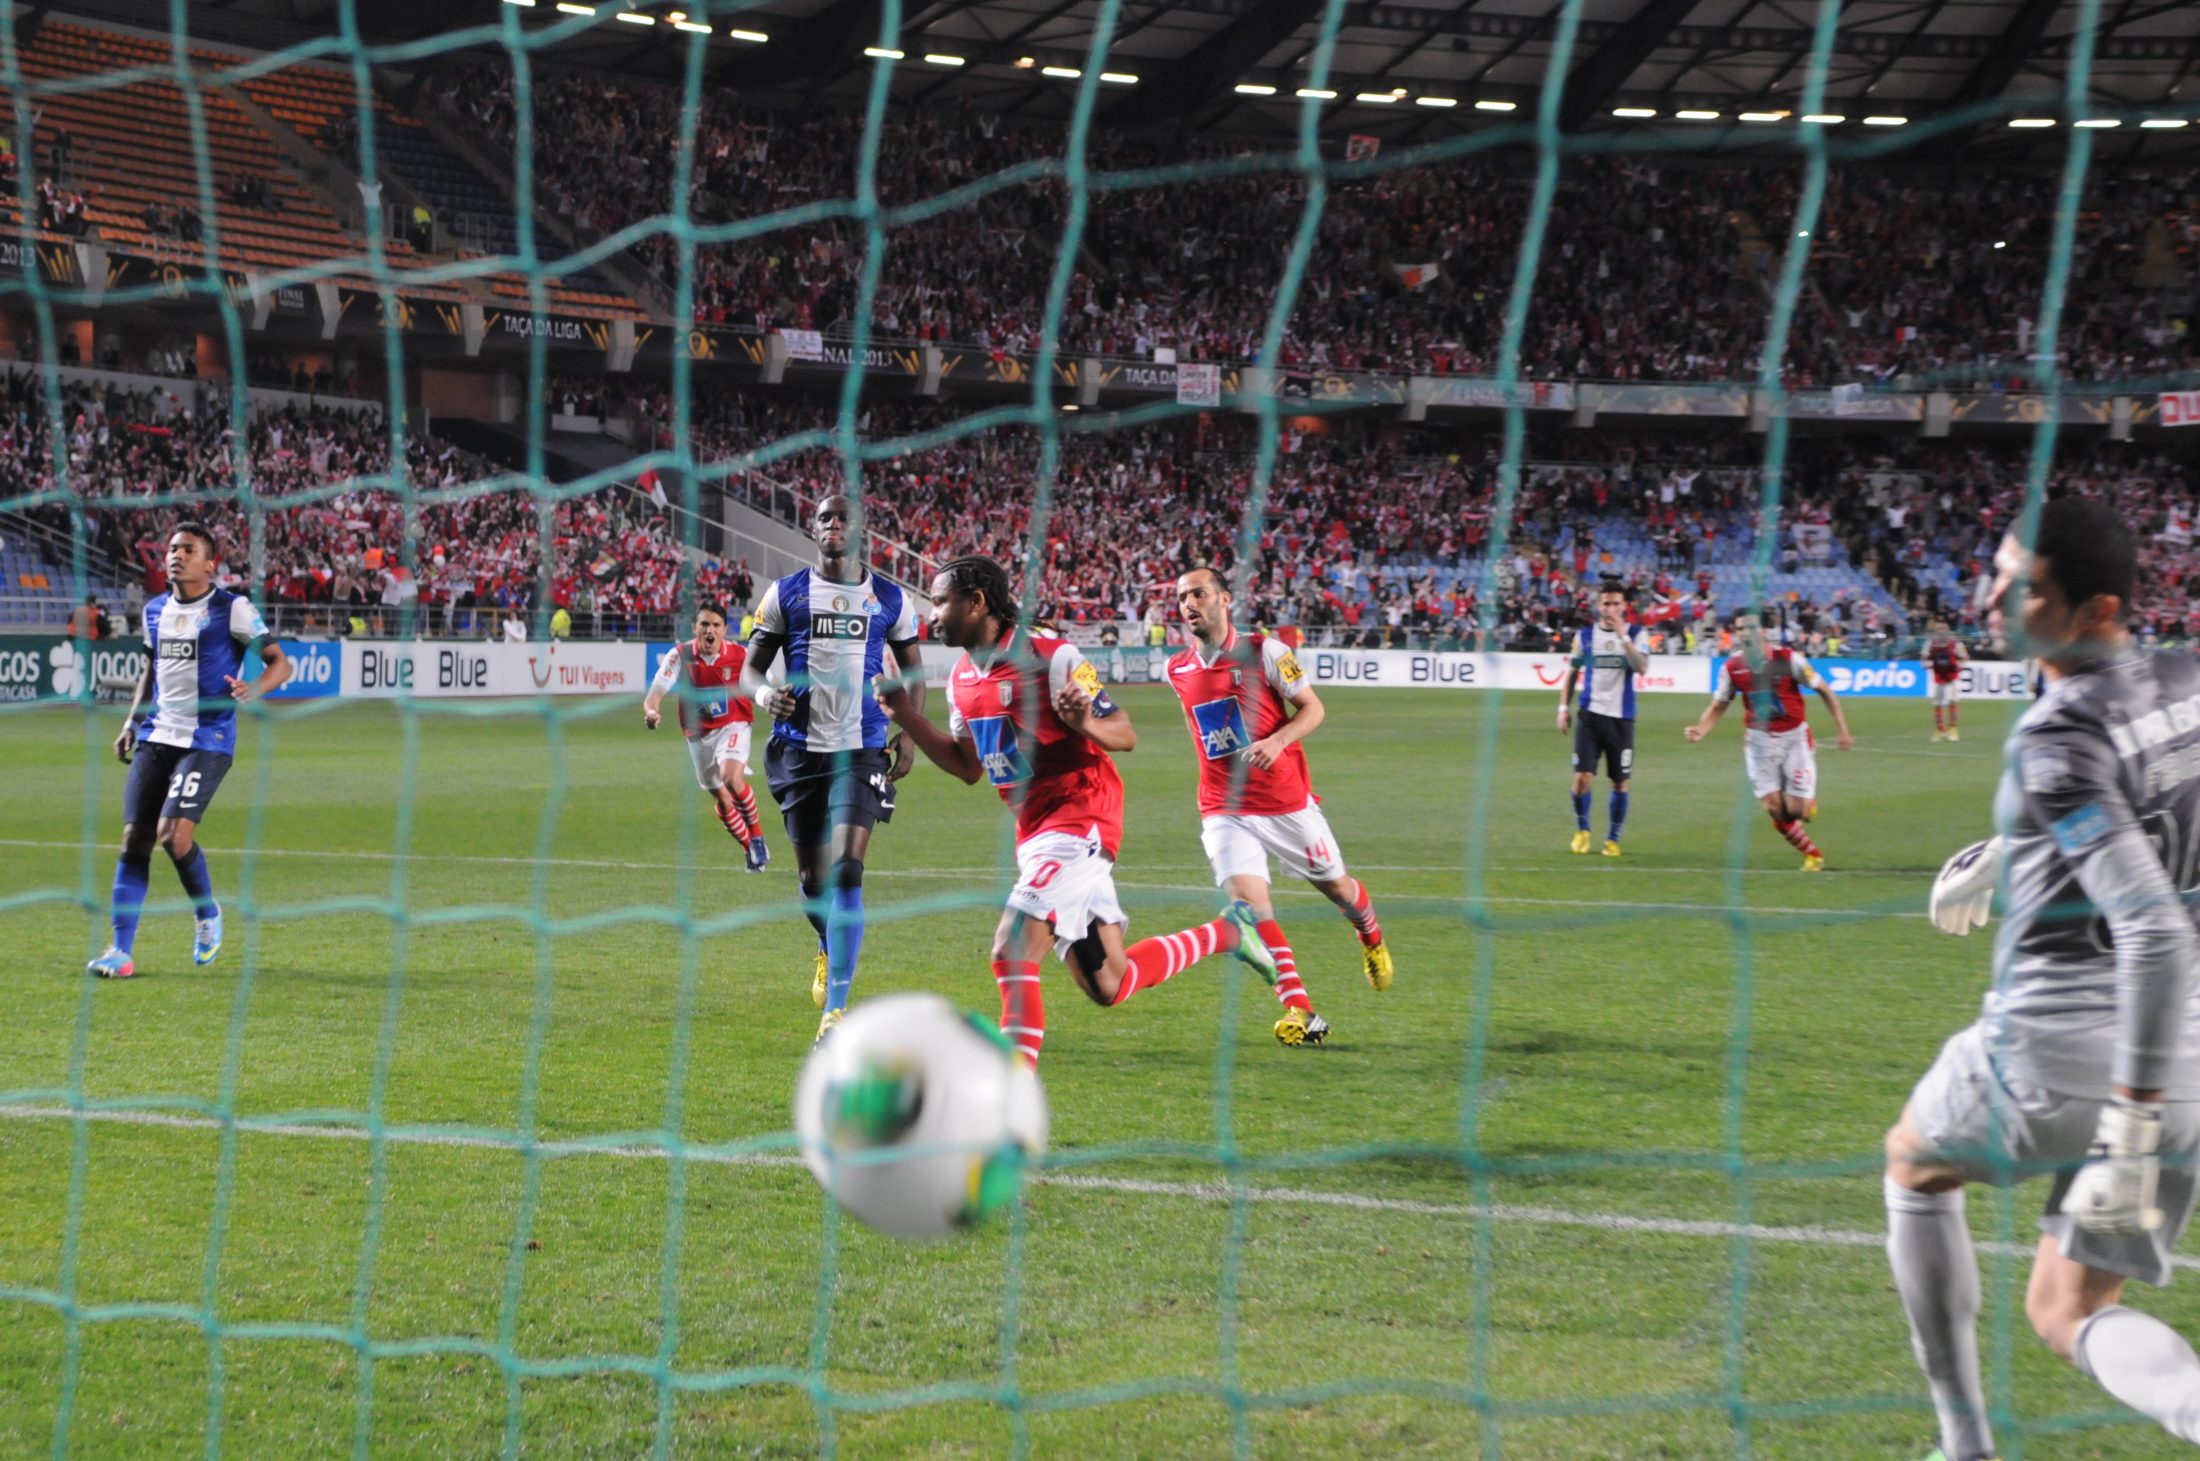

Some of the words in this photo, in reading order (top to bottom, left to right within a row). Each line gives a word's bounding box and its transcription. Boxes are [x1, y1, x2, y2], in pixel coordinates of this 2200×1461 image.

[0, 242, 37, 268] 2013
[504, 315, 532, 338] TAÇA
[535, 320, 552, 337] DA
[555, 322, 582, 339] LIGA
[860, 349, 893, 367] 2013
[1125, 367, 1157, 387] TAÇA
[1160, 370, 1177, 385] DA
[816, 617, 864, 635] MEO
[161, 642, 192, 658] MEO
[361, 650, 414, 688] Blue
[439, 650, 487, 688] Blue
[559, 665, 579, 685] TUI
[581, 664, 625, 689] Viagens
[1317, 654, 1379, 681] Blue
[1412, 657, 1475, 683] Blue
[1853, 662, 1917, 692] prio
[1206, 726, 1242, 754] AXA
[983, 752, 1019, 778] AXA
[168, 771, 201, 798] 26
[1304, 836, 1332, 869] 14
